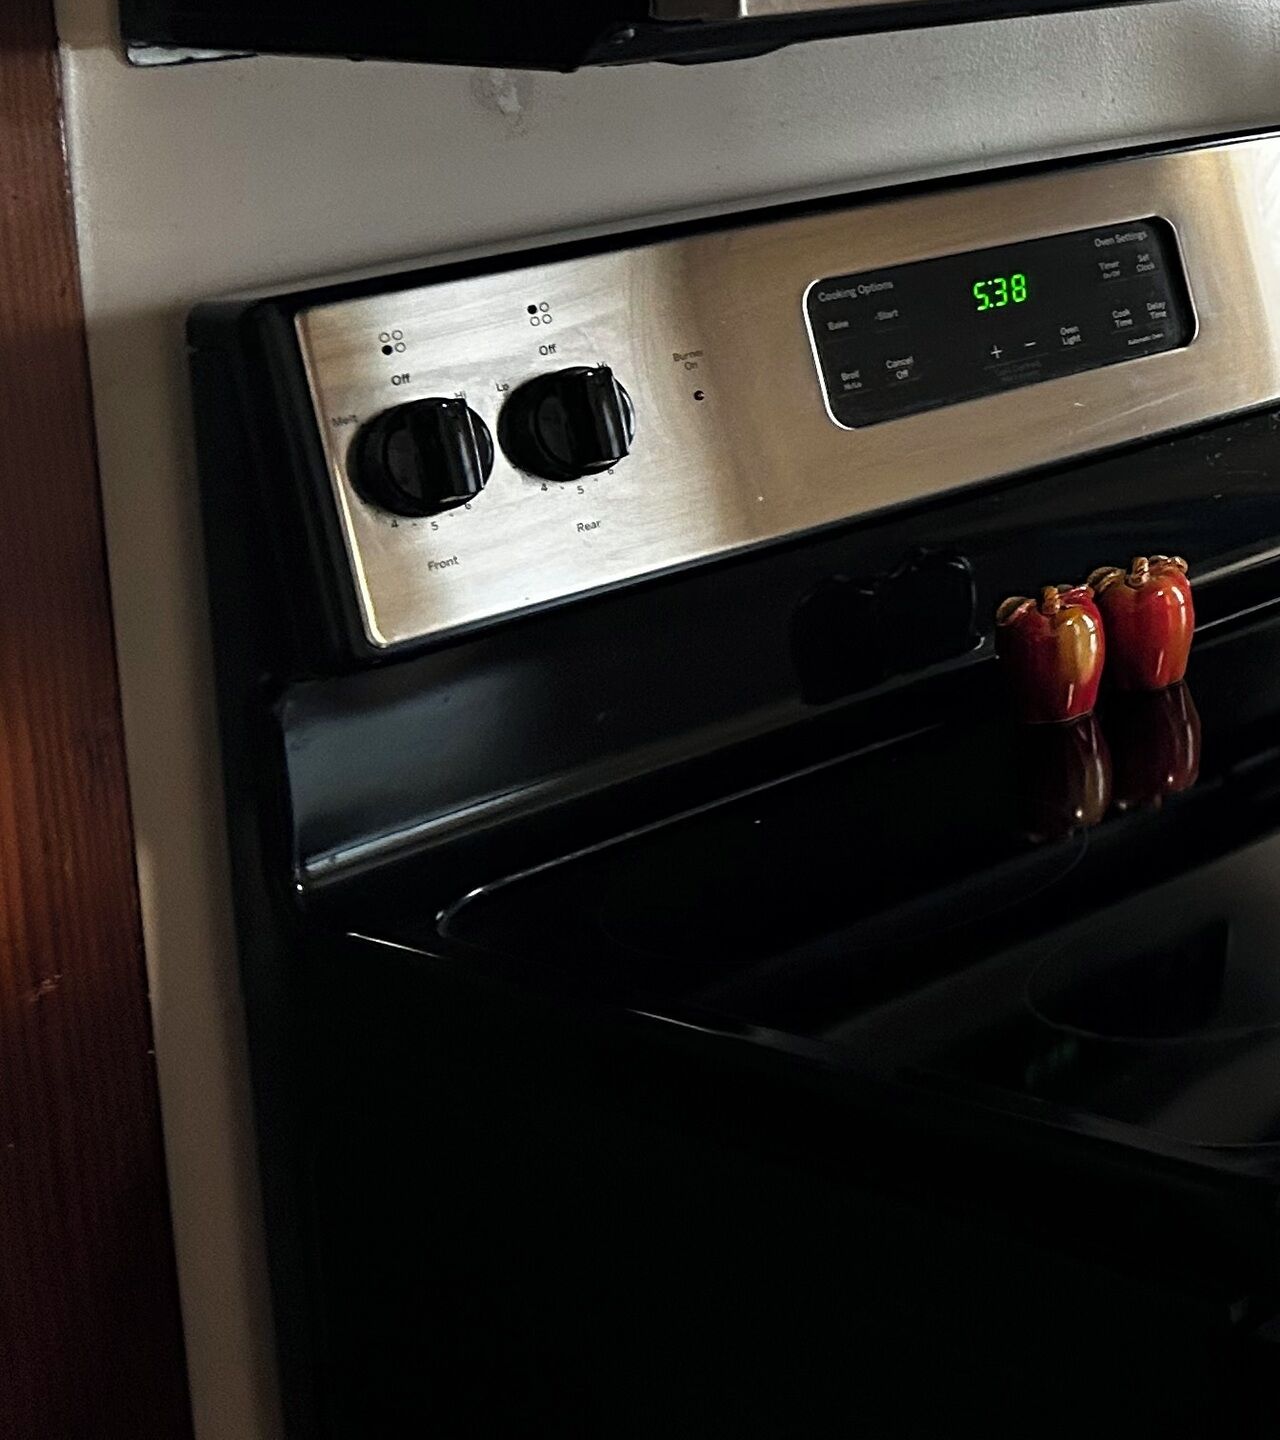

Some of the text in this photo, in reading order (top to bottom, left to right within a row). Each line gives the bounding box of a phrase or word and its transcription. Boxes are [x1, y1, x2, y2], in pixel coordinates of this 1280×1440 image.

[1094, 231, 1148, 248] Oven Settings
[818, 281, 894, 302] Cooking Options
[973, 273, 1026, 311] 5:38
[539, 343, 557, 356] Off
[672, 349, 704, 362] Burner
[391, 373, 411, 386] Off
[496, 382, 510, 392] Lo
[541, 483, 548, 491] 4
[577, 485, 584, 495] 5
[391, 519, 399, 528] 4
[431, 521, 439, 531] 5
[576, 520, 601, 532] Rear
[427, 556, 460, 571] Front
